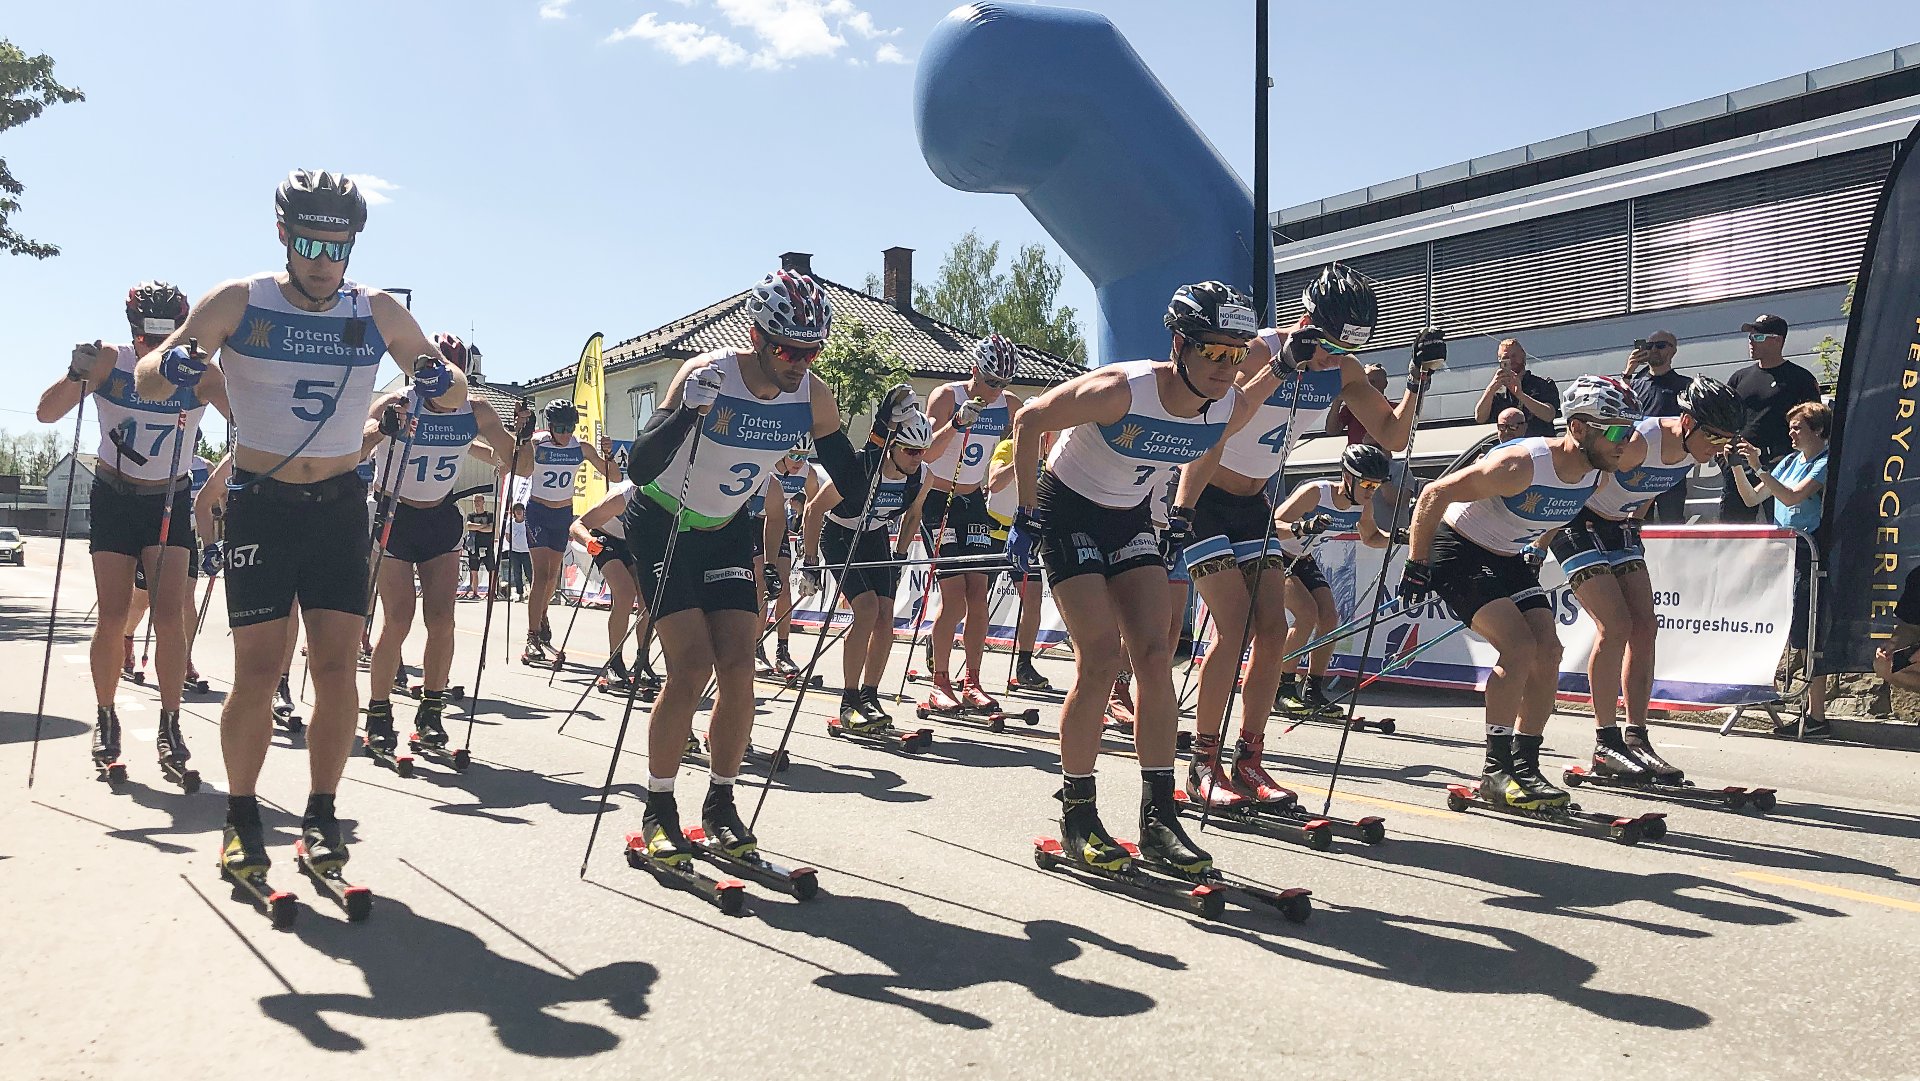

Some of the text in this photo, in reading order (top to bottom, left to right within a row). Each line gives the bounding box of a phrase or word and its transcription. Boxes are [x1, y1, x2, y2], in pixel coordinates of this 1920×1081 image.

[298, 213, 350, 225] MOELVEN
[284, 326, 341, 343] Totens
[291, 379, 336, 422] 5
[423, 422, 454, 433] Totens
[742, 413, 782, 429] Totens
[970, 422, 1005, 432] parebank
[422, 432, 472, 442] Sparebank
[736, 427, 803, 442] Sparebank
[1149, 431, 1194, 446] Totens
[1257, 423, 1288, 454] 4
[963, 442, 984, 467] 9
[409, 455, 459, 482] 15
[1133, 465, 1157, 485] 7
[542, 471, 572, 489] 20
[719, 462, 761, 496] 3
[1547, 497, 1578, 508] Totens
[705, 569, 744, 581] SpareBank
